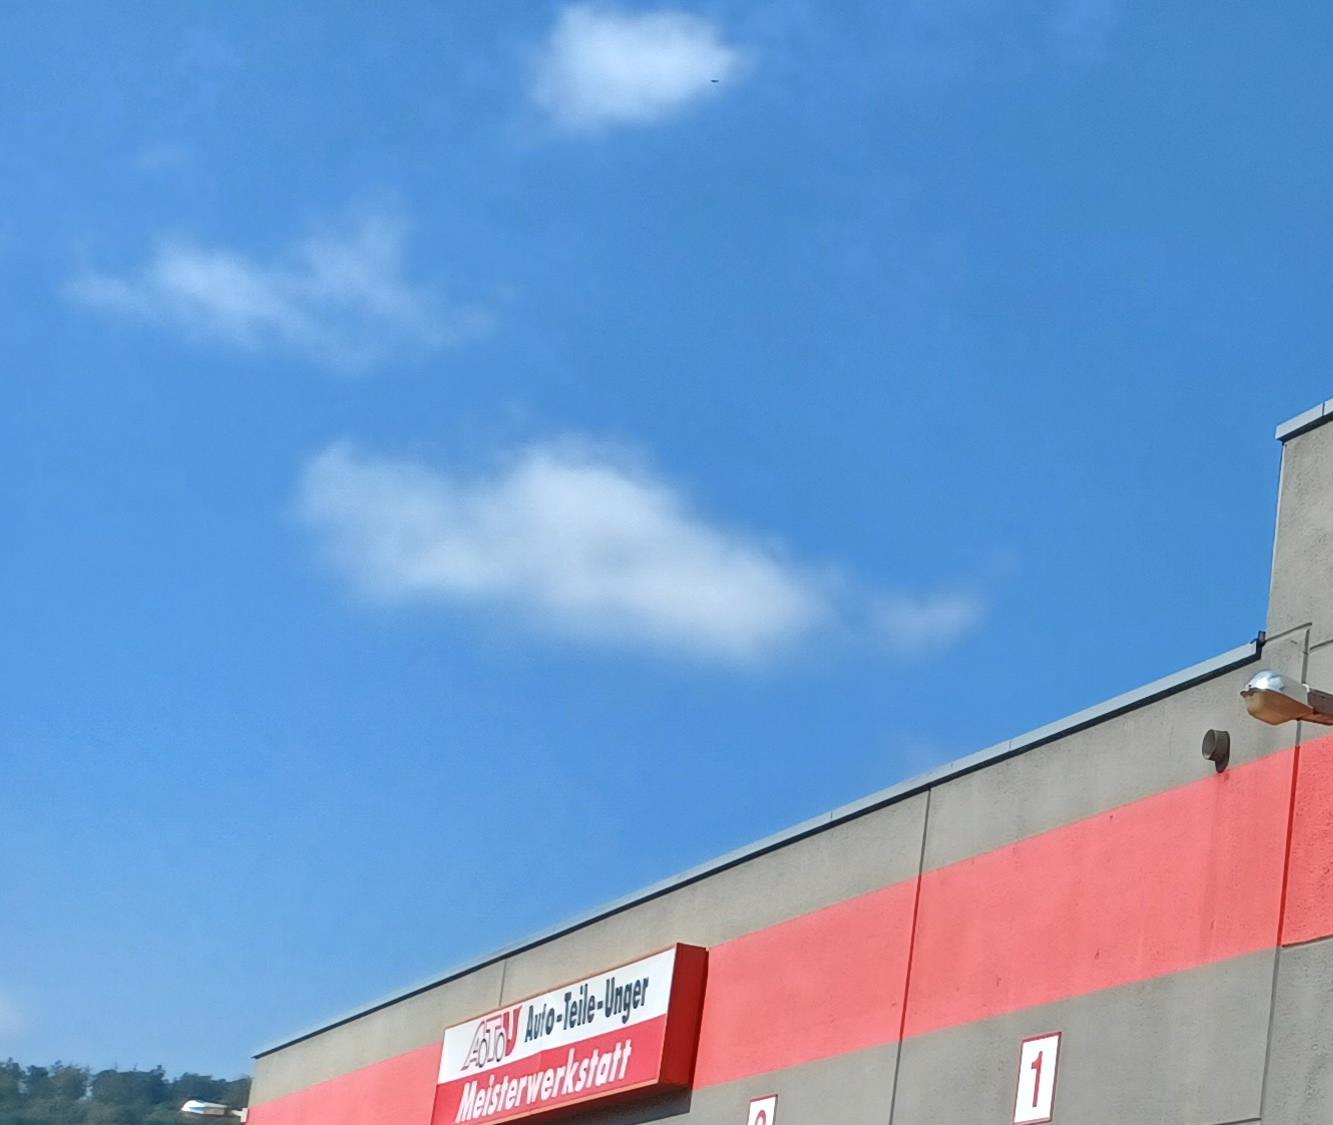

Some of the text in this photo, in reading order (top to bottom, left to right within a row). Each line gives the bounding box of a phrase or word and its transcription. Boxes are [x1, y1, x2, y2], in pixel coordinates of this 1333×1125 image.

[524, 976, 649, 1043] Auto-Teile-Unger
[454, 1039, 632, 1124] Meisterwerkstatt
[1031, 1050, 1043, 1107] 1
